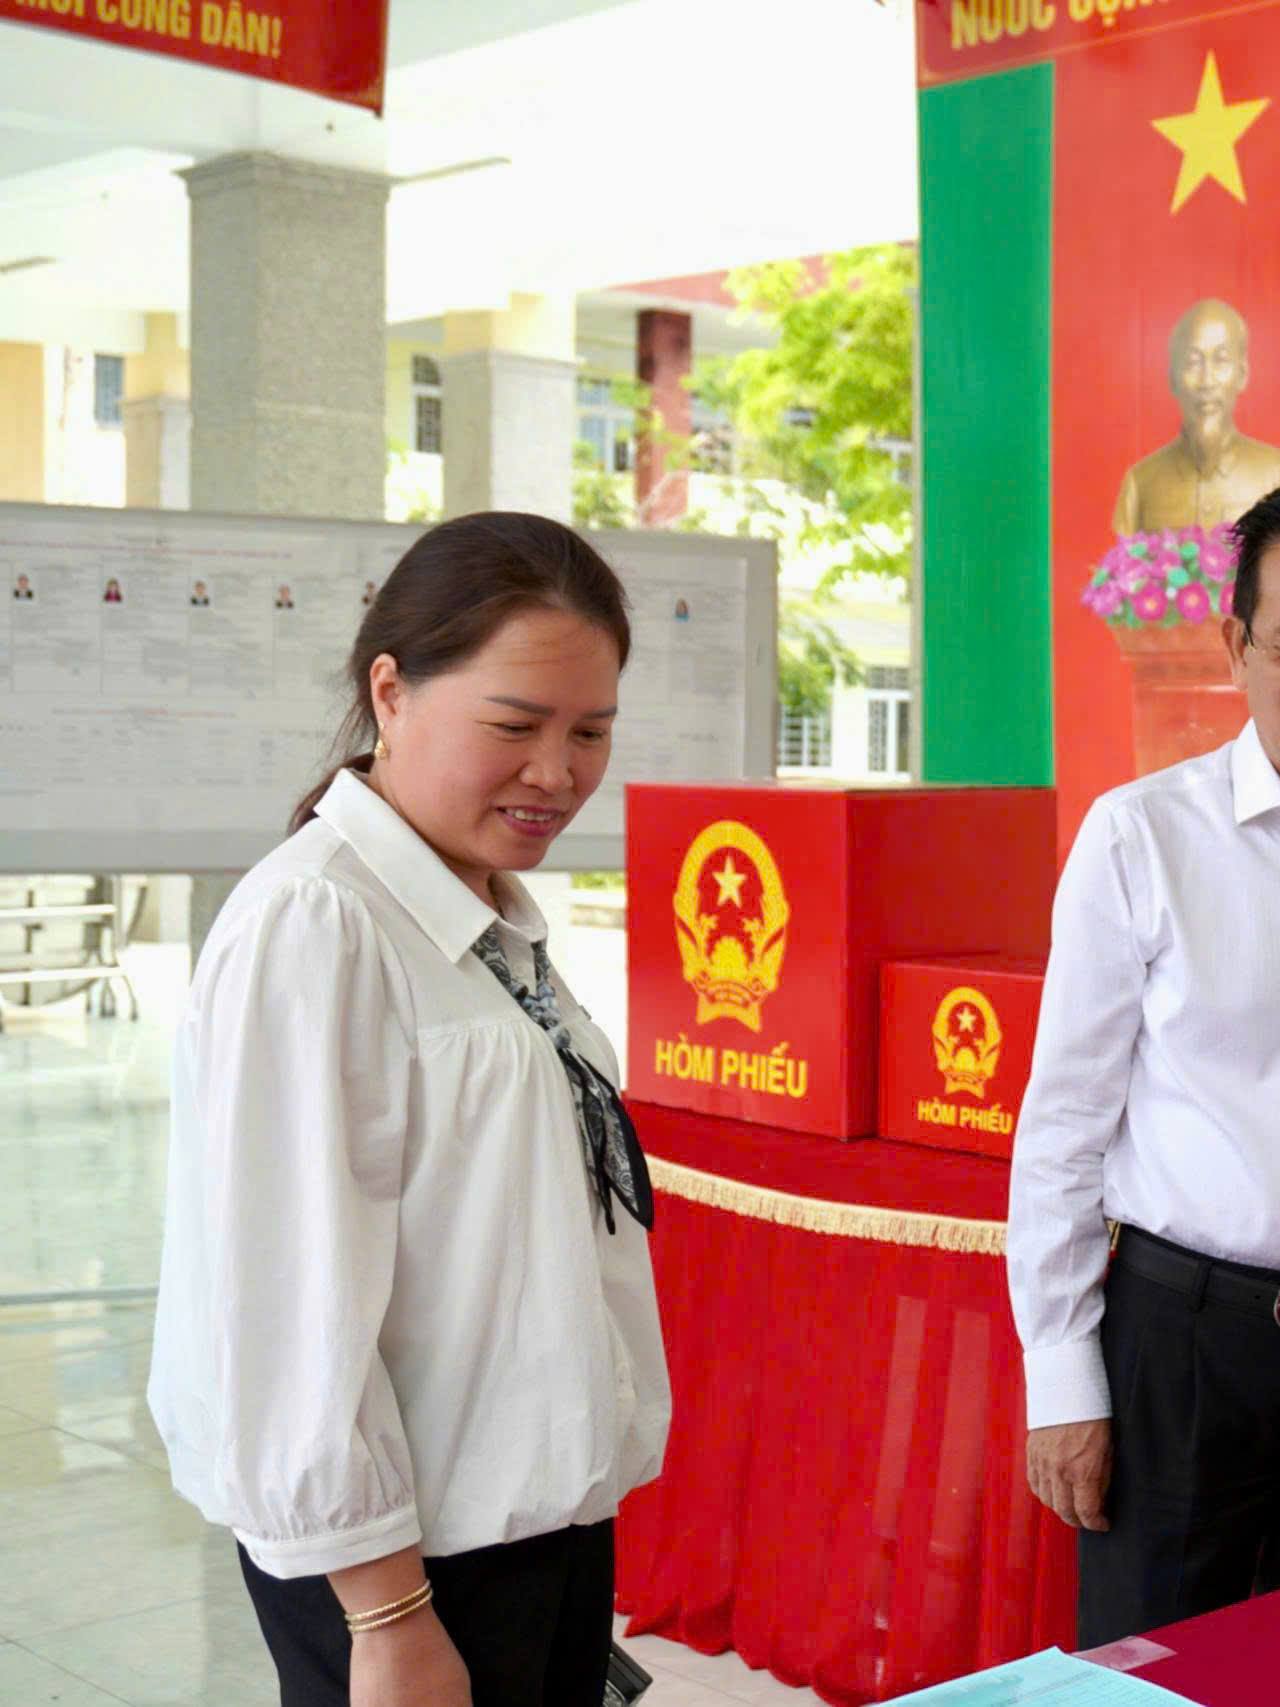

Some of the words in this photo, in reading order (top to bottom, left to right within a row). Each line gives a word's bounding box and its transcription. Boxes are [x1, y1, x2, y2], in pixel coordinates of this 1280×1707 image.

[202, 0, 282, 58] DÂN!
[655, 1033, 716, 1085] HÒM
[720, 1041, 808, 1098] PHIẾU
[917, 1098, 956, 1125] HÒM
[959, 1102, 1013, 1135] PHIẾU
